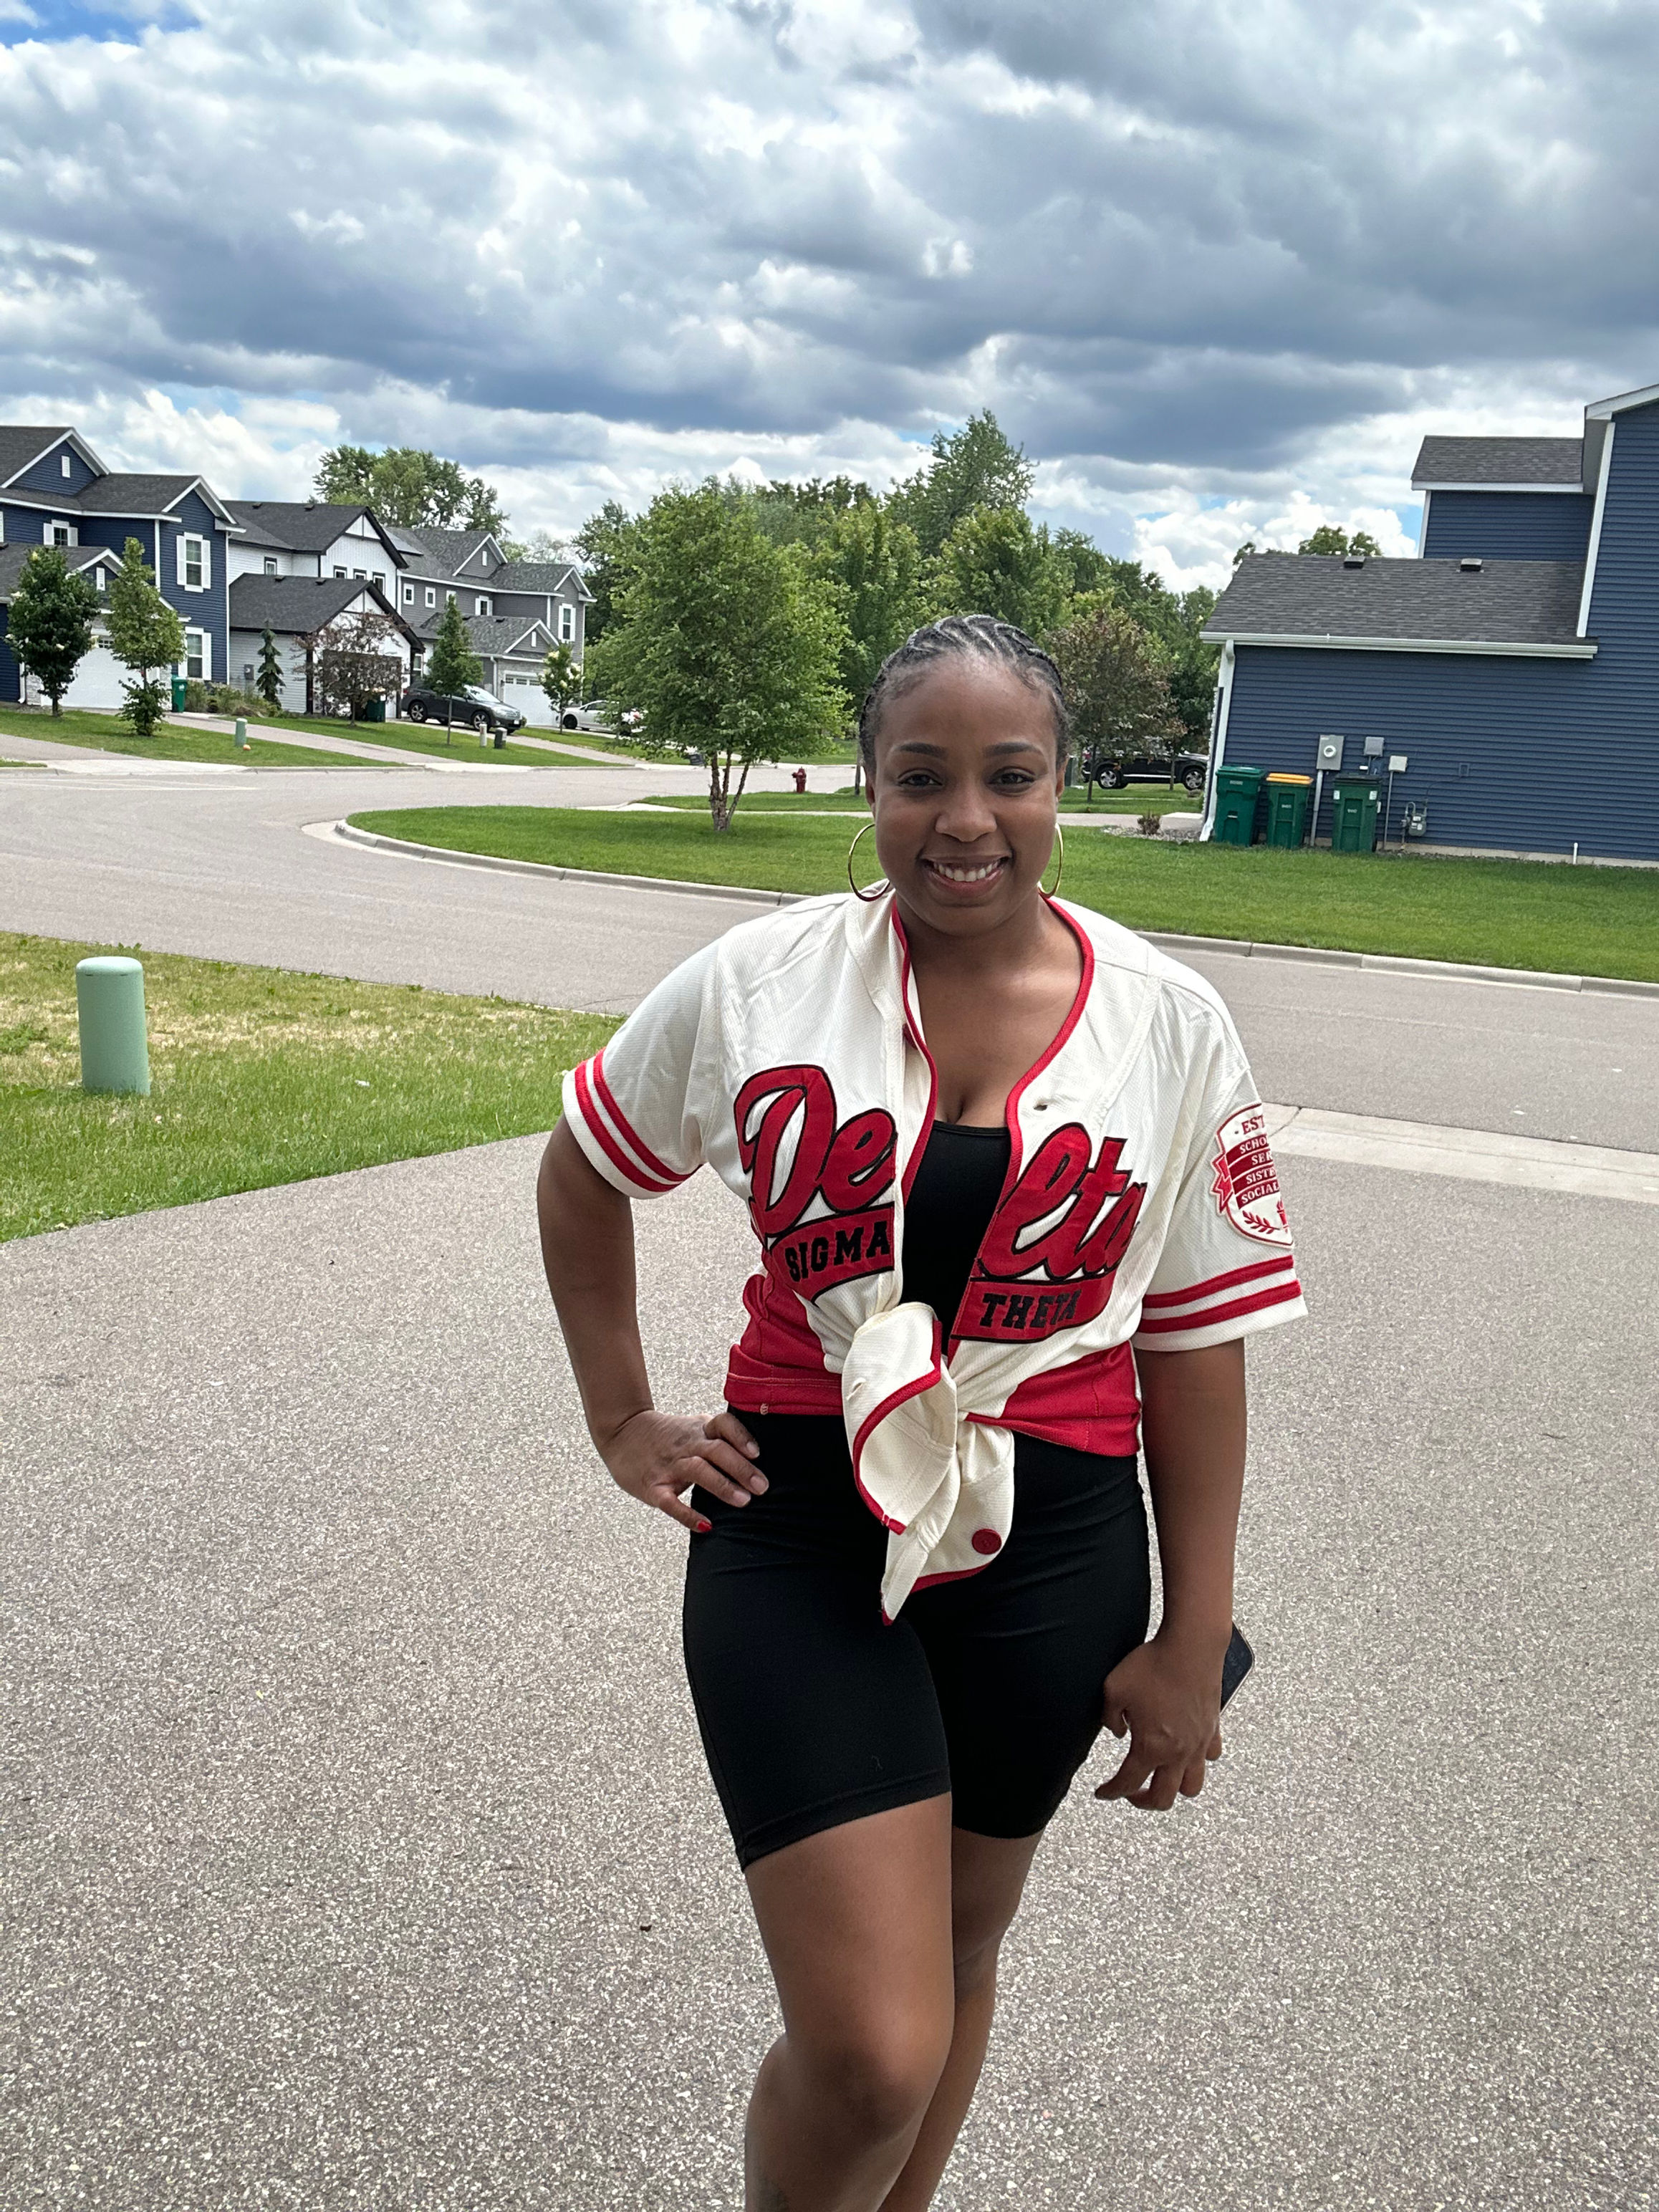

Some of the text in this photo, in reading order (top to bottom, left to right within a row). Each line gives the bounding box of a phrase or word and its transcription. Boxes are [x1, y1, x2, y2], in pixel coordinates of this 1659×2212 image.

[734, 1064, 898, 1237] De
[1241, 1182, 1279, 1203] SOCIAL
[785, 1221, 1082, 1329] SIGMA THETA
